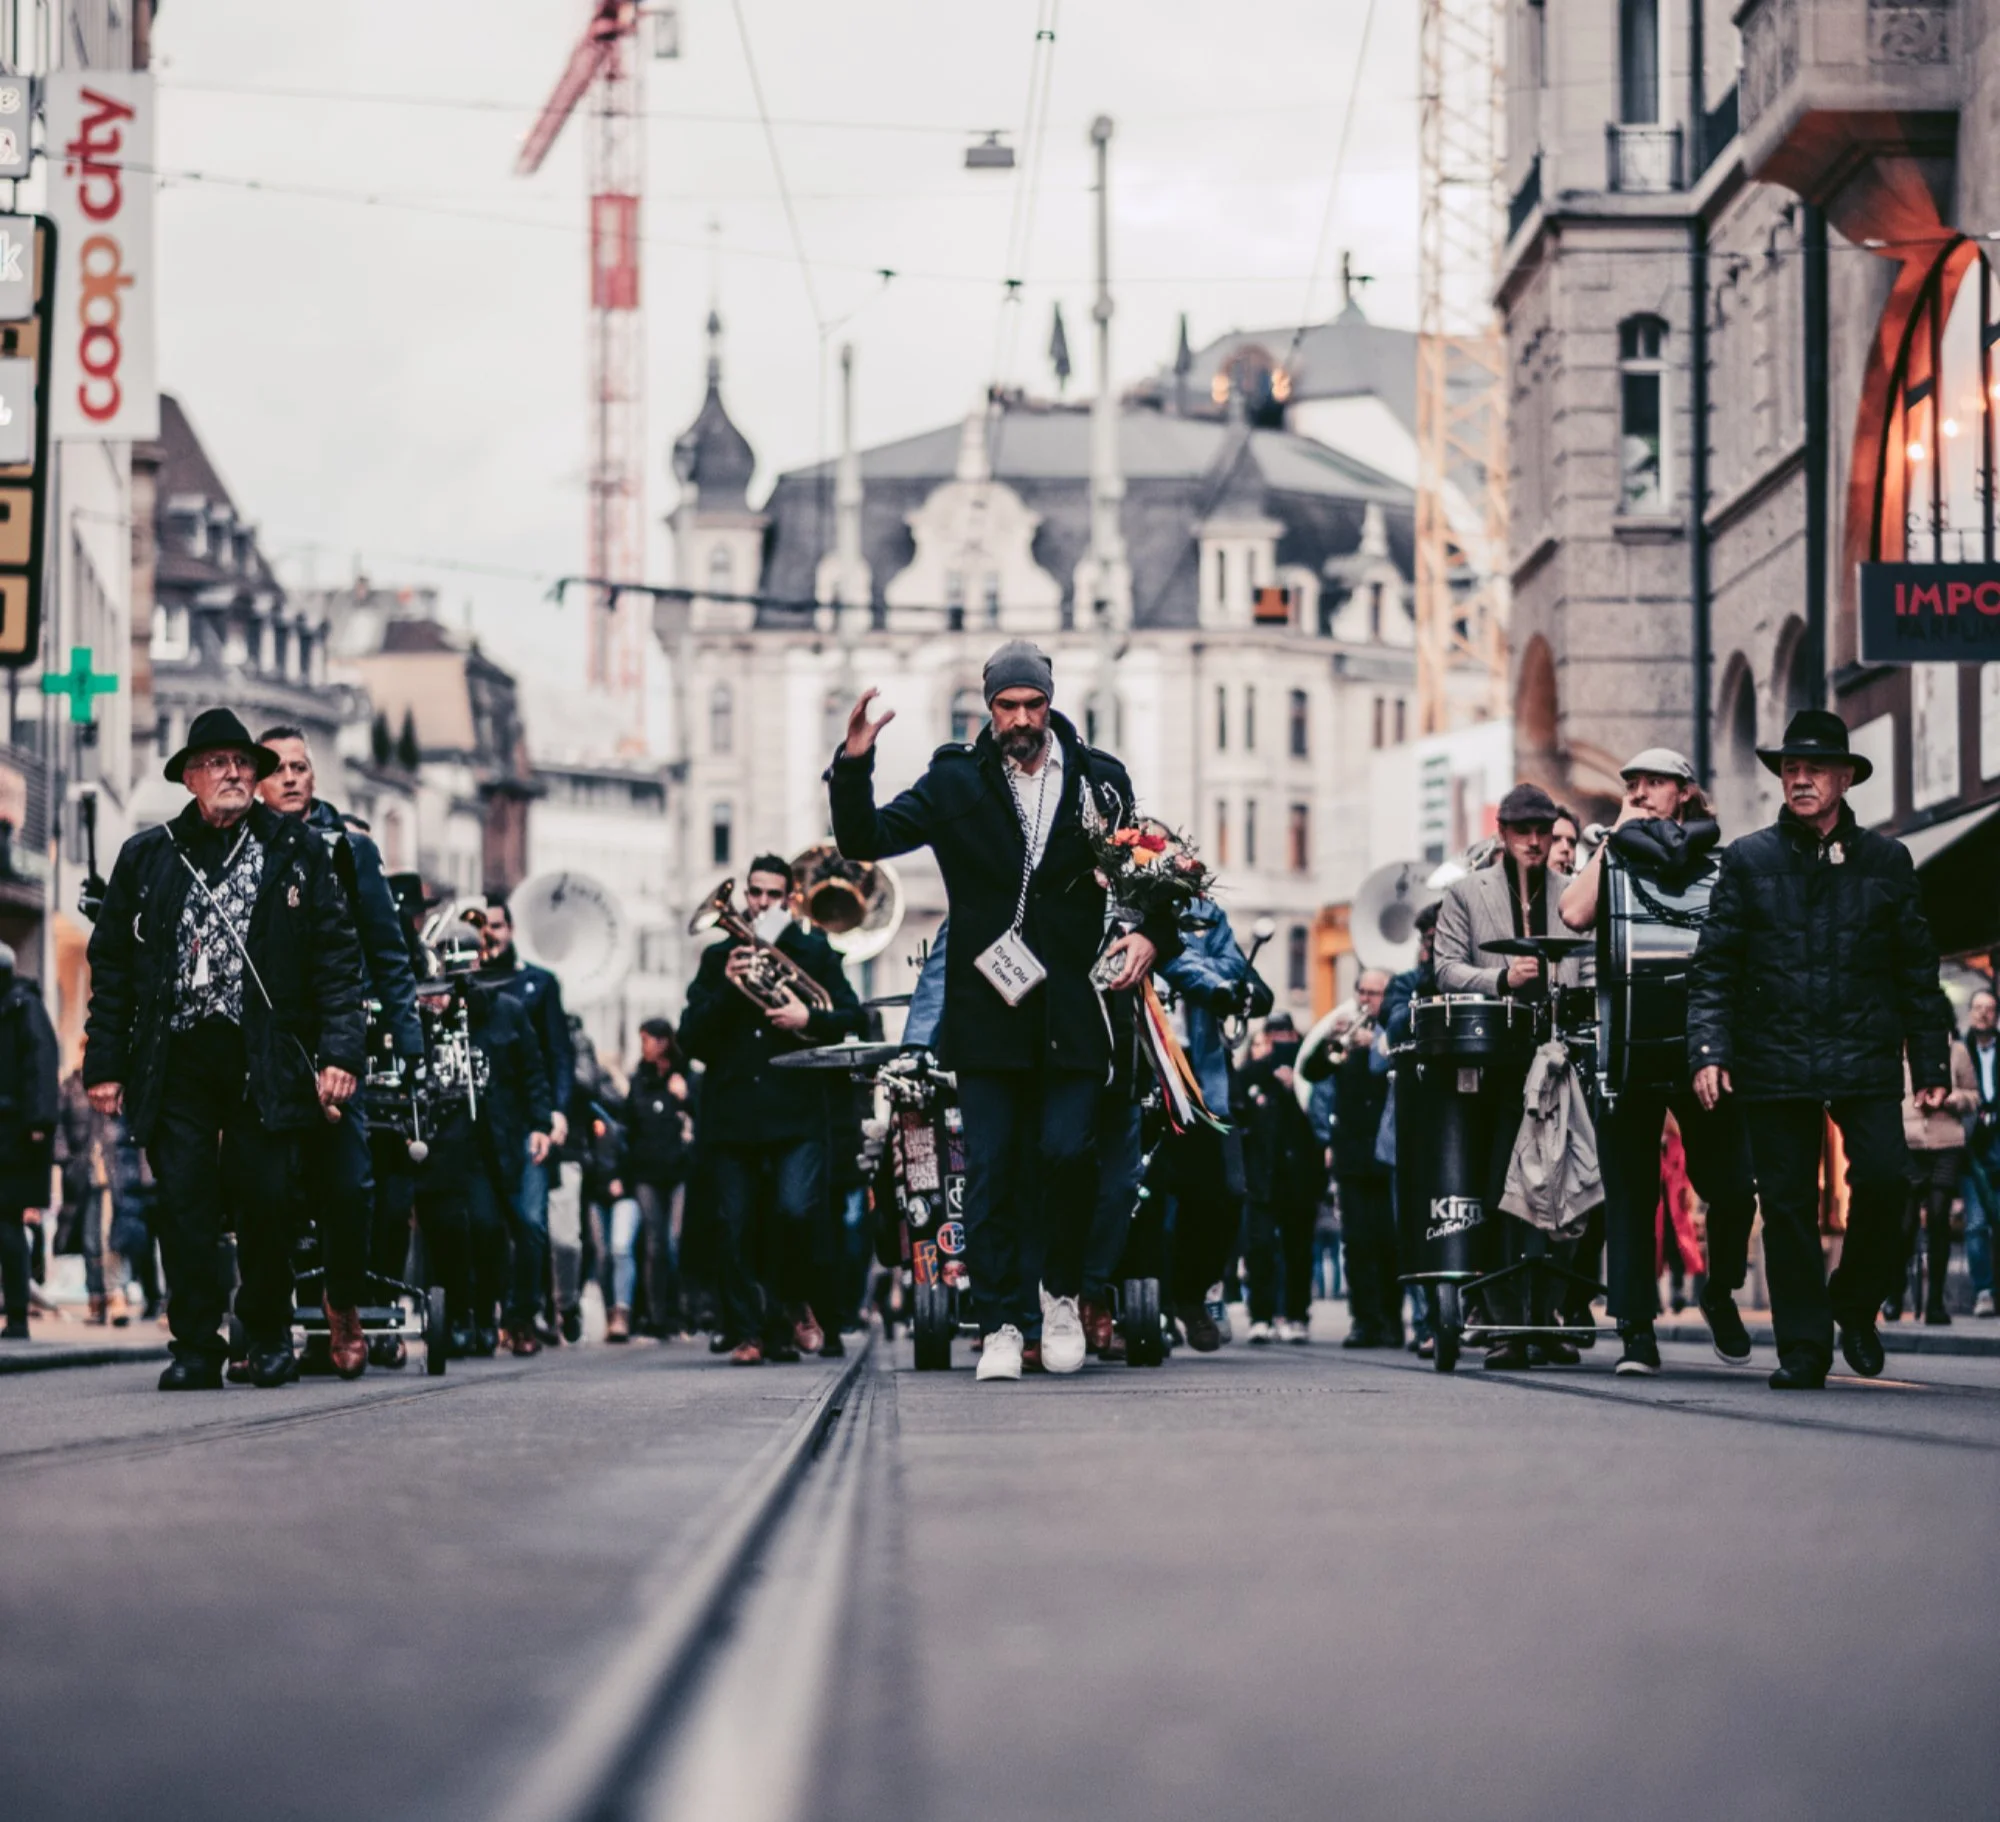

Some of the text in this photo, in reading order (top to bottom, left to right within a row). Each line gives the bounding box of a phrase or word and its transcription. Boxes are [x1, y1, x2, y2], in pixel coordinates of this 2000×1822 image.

[64, 84, 136, 423] coop city
[1895, 581, 2000, 616] IMPO
[991, 960, 1012, 987] Town
[993, 945, 1029, 984] Dirty Old
